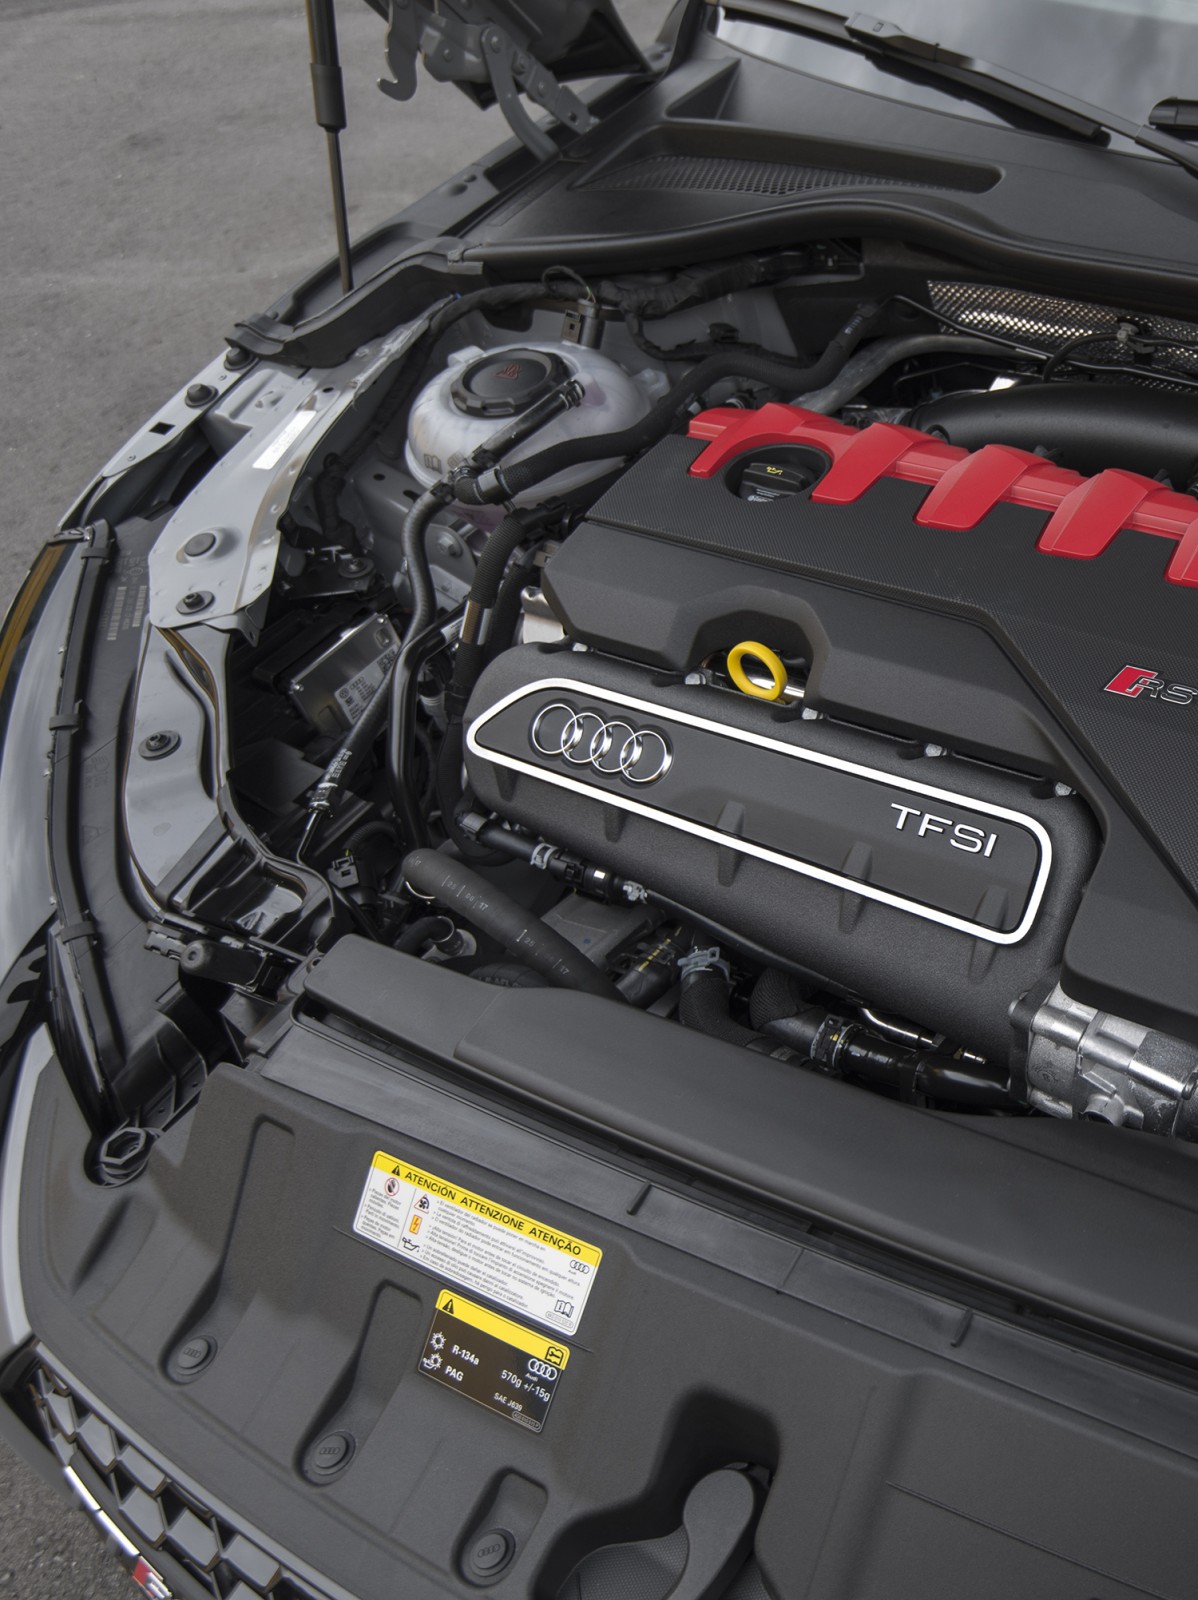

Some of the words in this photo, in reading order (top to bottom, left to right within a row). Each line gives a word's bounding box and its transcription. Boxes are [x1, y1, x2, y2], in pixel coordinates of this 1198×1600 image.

[1110, 669, 1198, 704] RS
[890, 803, 998, 858] TFSI
[404, 1170, 456, 1200] ATENCIÓN
[459, 1194, 524, 1230] ATTENZIONE
[528, 1224, 582, 1255] ATENÇÃO
[452, 1344, 480, 1366] R-134a
[445, 1365, 464, 1381] PAG
[501, 1369, 522, 1388] 570g
[523, 1382, 551, 1402] +/-15g
[525, 1372, 539, 1382] Audi
[494, 1392, 507, 1404] SAE
[507, 1399, 523, 1411] J639
